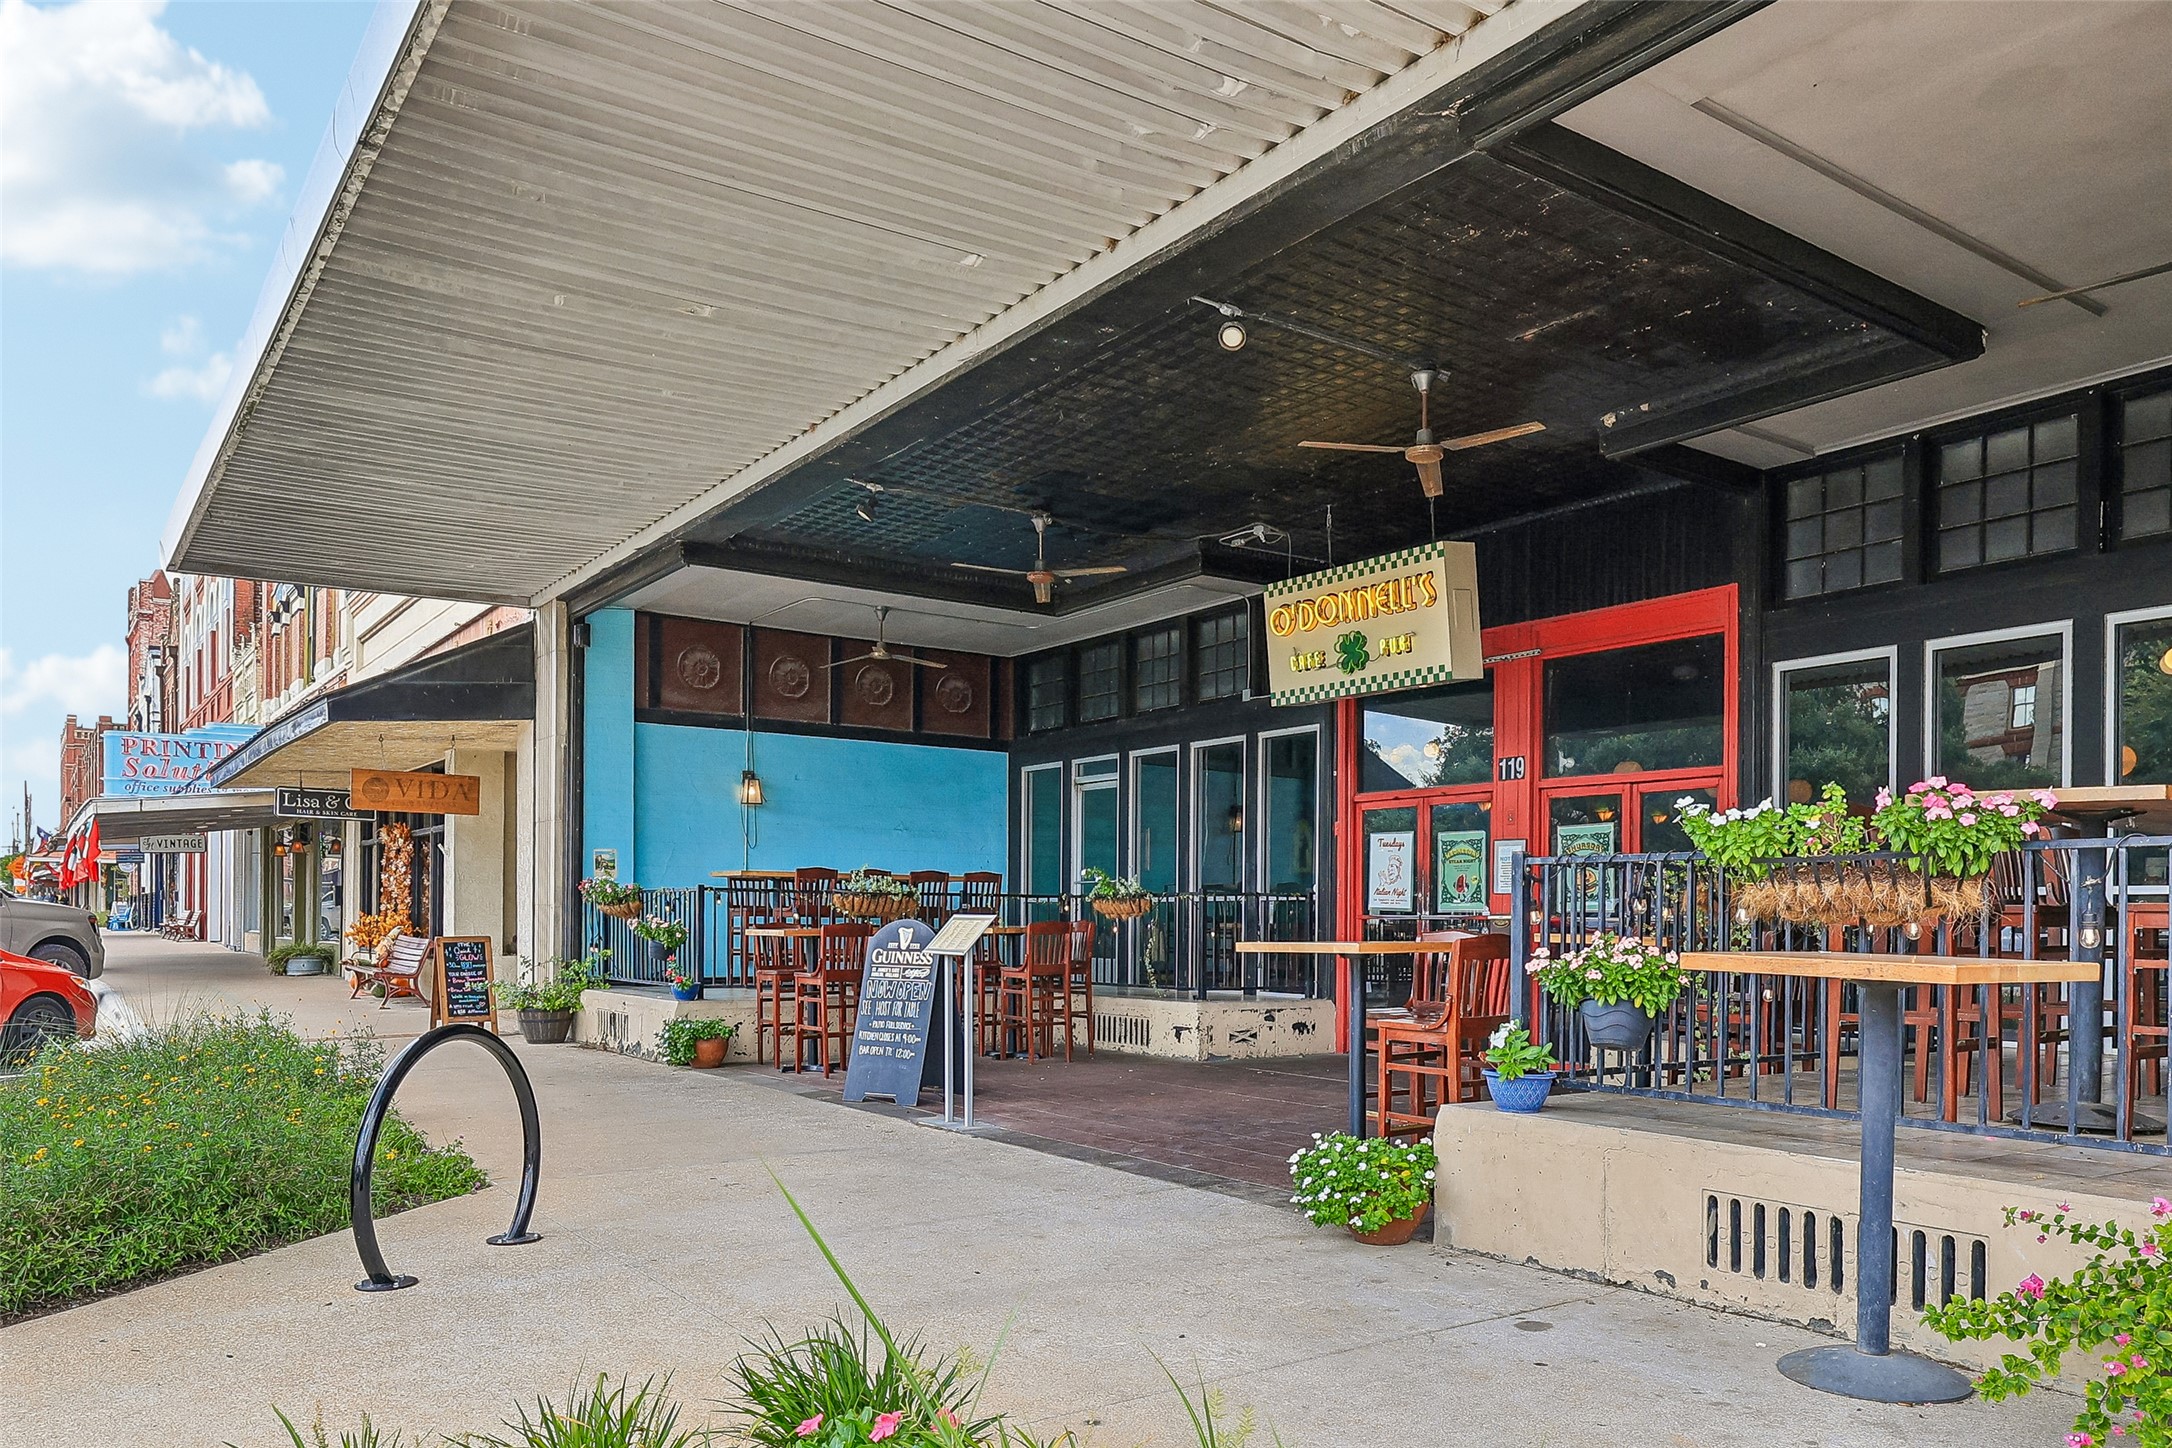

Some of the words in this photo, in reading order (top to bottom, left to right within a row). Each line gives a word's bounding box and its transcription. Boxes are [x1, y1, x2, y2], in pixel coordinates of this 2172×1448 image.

[1269, 570, 1437, 637] O'DONNELL'S
[1379, 634, 1413, 657] PUB
[121, 737, 243, 759] PRINTIN
[122, 757, 213, 780] Soluti
[1499, 757, 1525, 780] 119
[124, 780, 159, 794] office
[163, 783, 212, 794] supplies
[394, 778, 470, 801] VIDA
[283, 792, 320, 808] Lisa
[326, 795, 340, 809] &
[156, 839, 203, 849] VINTAGE
[1377, 838, 1405, 851] Tuesdays
[1566, 842, 1606, 854] THURSDAY
[872, 948, 933, 964] GUINNESS
[866, 980, 897, 998] NOW
[896, 982, 932, 1000] OPEN
[860, 1000, 872, 1015] SEE
[875, 1001, 892, 1016] HOST
[892, 1002, 902, 1016] FOR
[904, 1002, 920, 1018] TABLE
[858, 1030, 879, 1041] KITCHEN
[858, 1044, 870, 1055] BAR
[870, 1046, 884, 1056] OPEN
